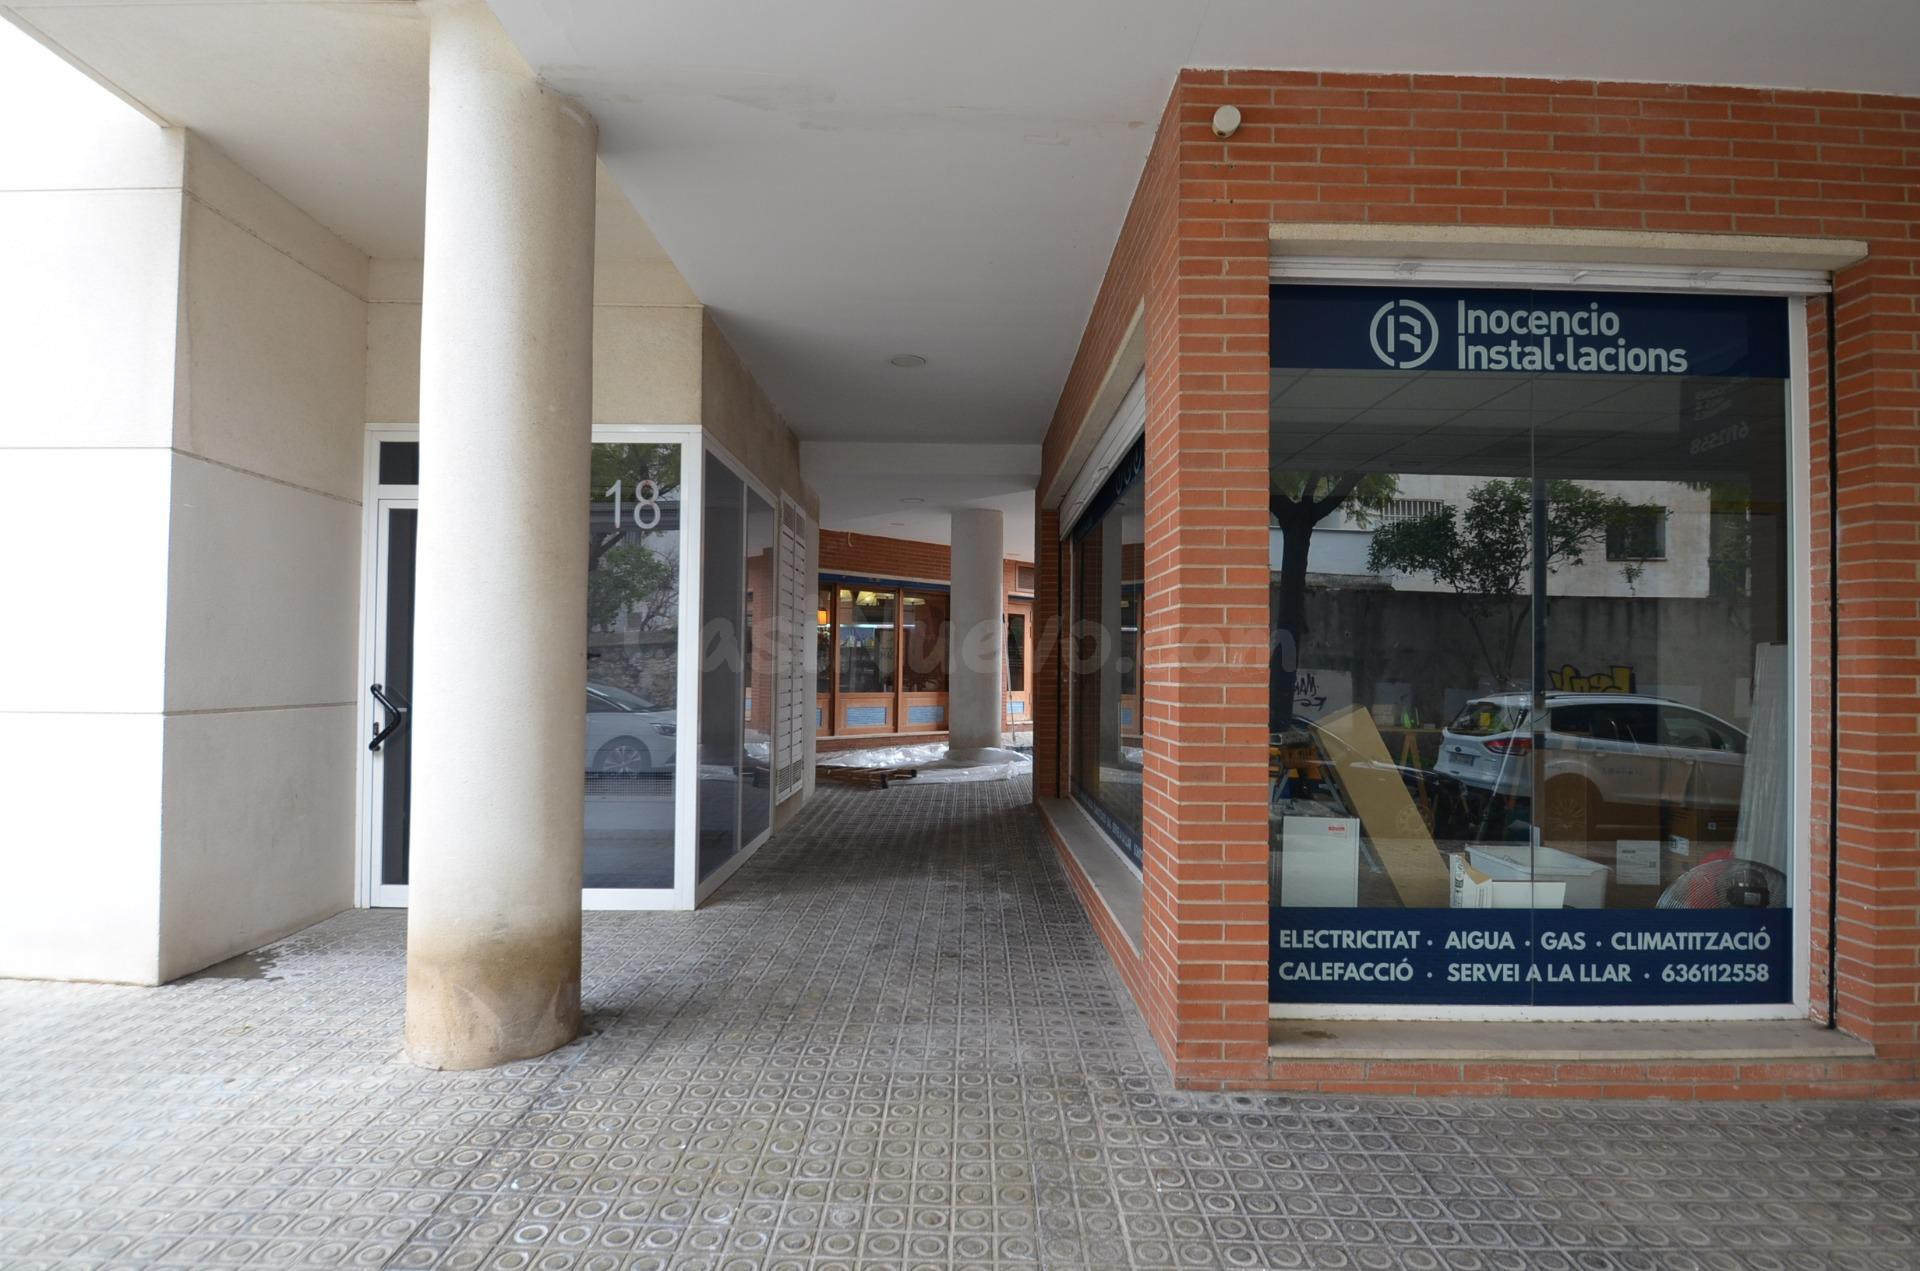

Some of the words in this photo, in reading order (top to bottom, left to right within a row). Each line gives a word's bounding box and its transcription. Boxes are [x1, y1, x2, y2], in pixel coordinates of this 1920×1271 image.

[1457, 300, 1620, 336] Inocencio
[604, 479, 662, 530] 18
[1279, 929, 1421, 949] ELECTRICITAT
[1444, 930, 1516, 950] AIGUA
[1540, 931, 1586, 951] GAS
[1610, 926, 1771, 951] CLIMATITZACIÓ
[1278, 957, 1414, 982] CALEFACCIÓ
[1446, 962, 1520, 982] SERVEI
[1525, 963, 1543, 982] A
[1547, 963, 1575, 982] LA
[1579, 963, 1633, 982] LLAR
[1661, 963, 1769, 983] 636112558
